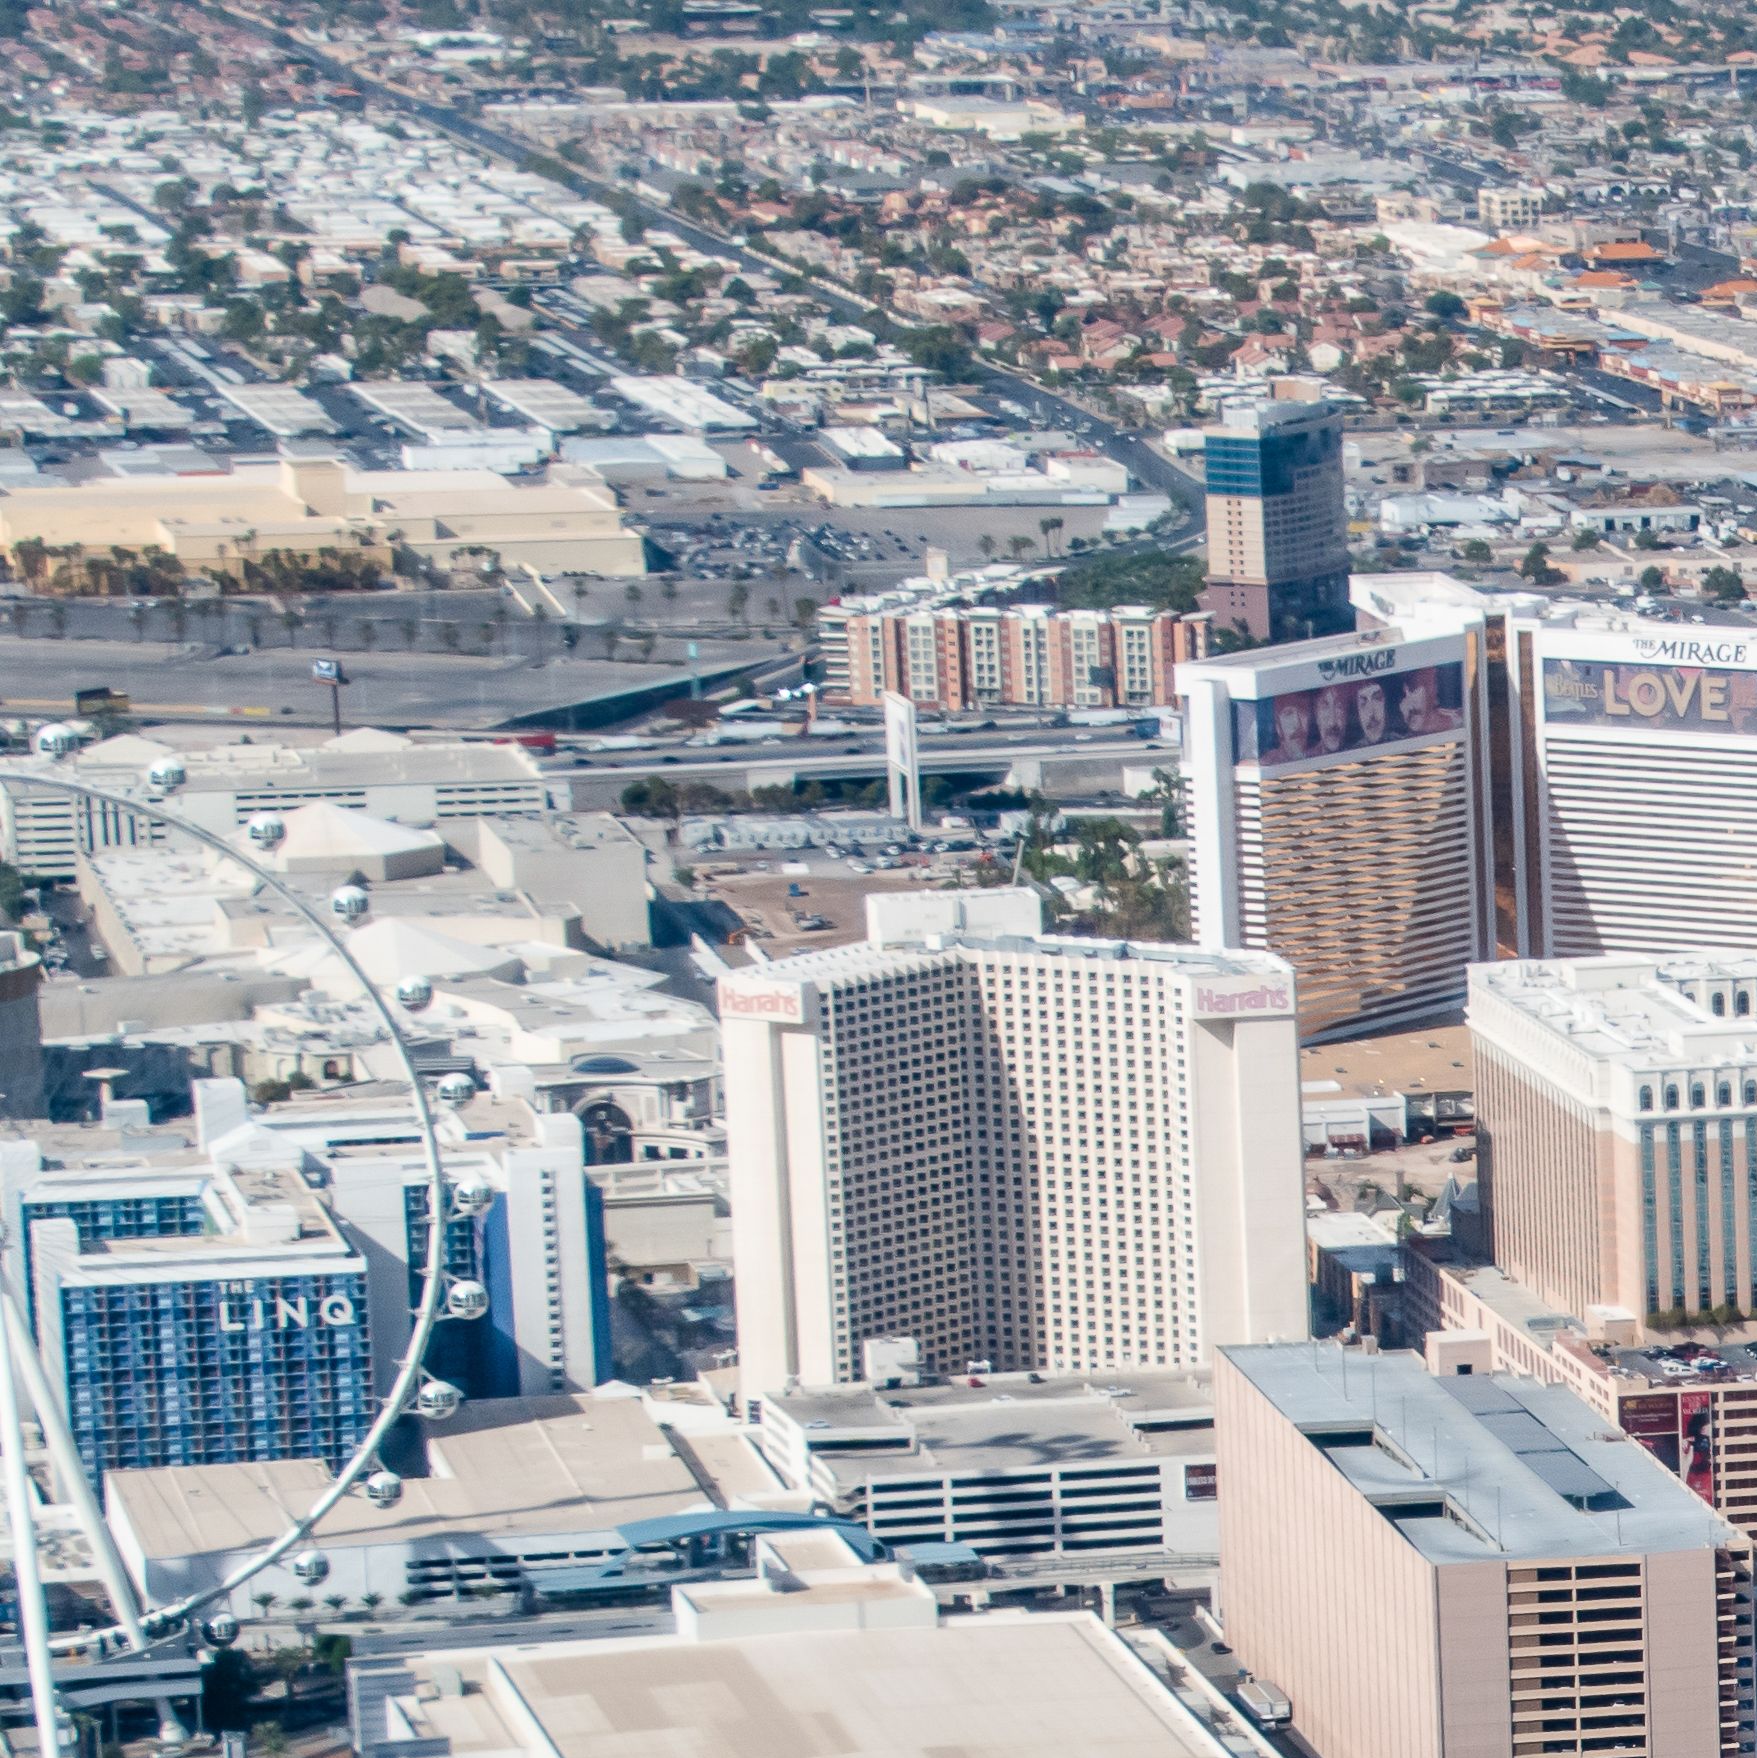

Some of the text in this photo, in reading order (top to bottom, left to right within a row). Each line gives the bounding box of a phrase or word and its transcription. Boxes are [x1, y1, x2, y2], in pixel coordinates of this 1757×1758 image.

[1323, 649, 1396, 681] MIRAGE
[1632, 639, 1747, 664] THE MIRAGE
[1604, 669, 1730, 722] LOVE
[218, 1280, 254, 1295] THE
[219, 1295, 356, 1331] LINQ
